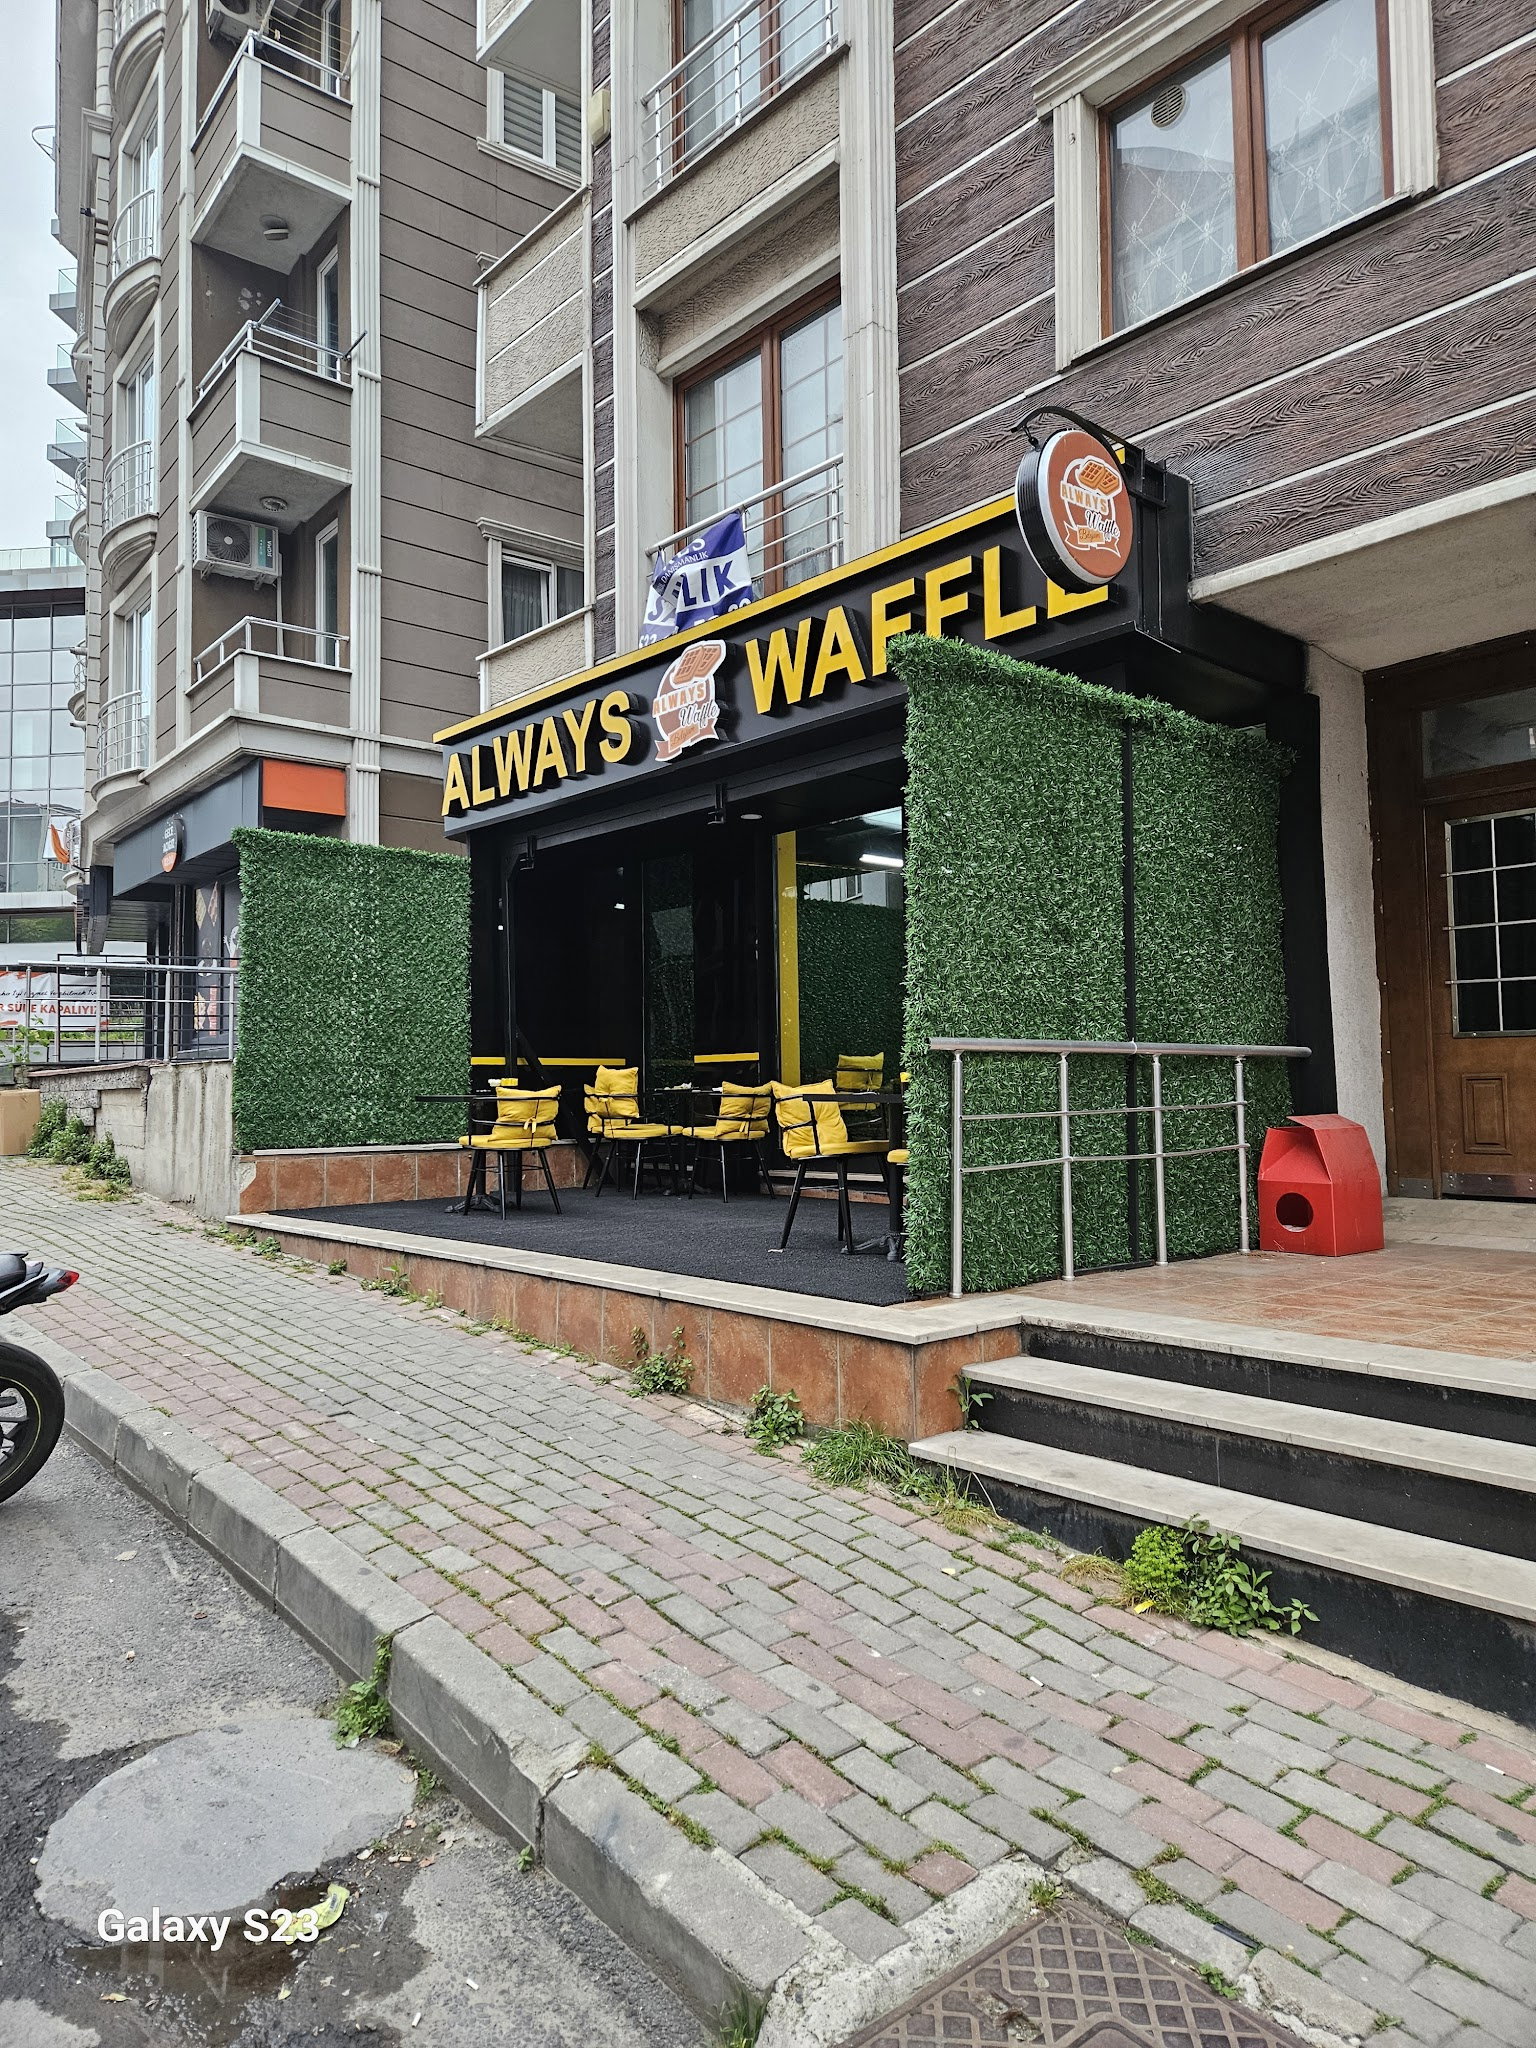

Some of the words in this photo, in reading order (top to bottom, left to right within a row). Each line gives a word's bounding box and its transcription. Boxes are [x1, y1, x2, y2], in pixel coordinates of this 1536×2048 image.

[1061, 484, 1108, 514] ALWAYS
[1085, 510, 1119, 541] Waffle
[653, 682, 706, 716] ALWAYS
[679, 701, 719, 728] Waffle
[441, 690, 632, 817] ALWAYS
